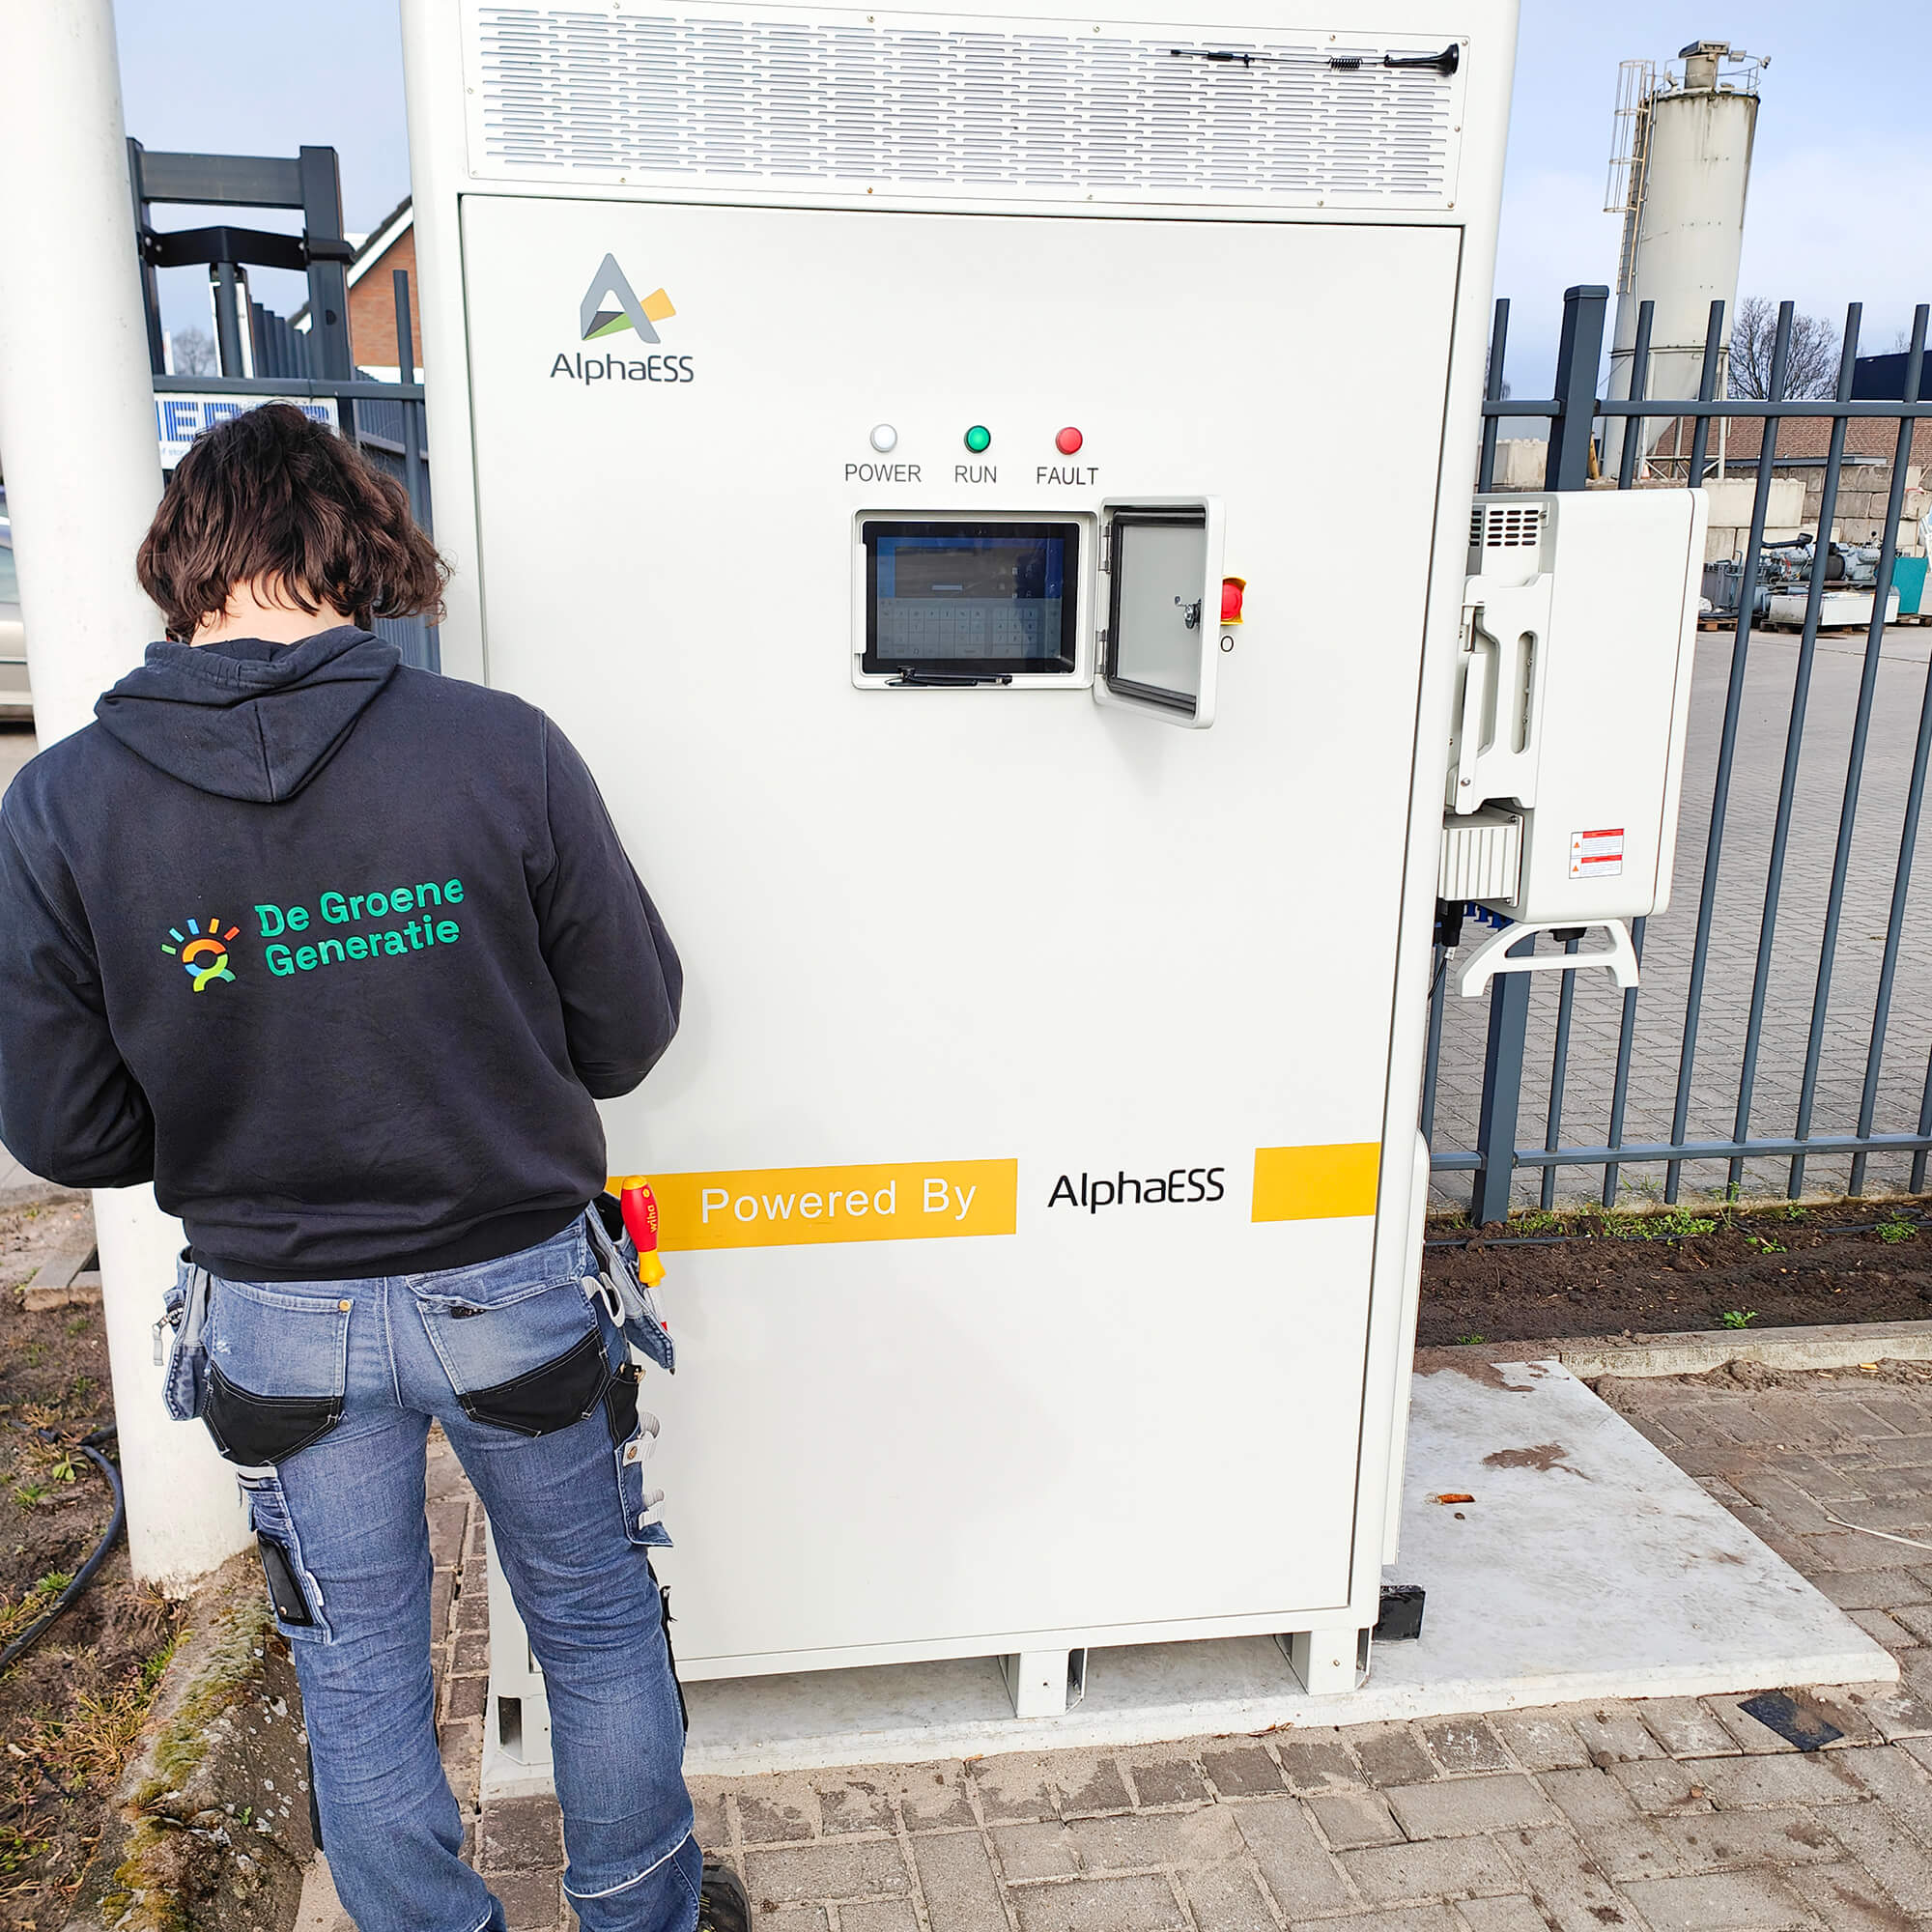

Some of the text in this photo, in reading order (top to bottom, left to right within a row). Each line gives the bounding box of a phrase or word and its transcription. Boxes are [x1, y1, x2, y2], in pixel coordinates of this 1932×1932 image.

[550, 352, 695, 385] AlphaESS
[844, 464, 922, 482] POWER
[954, 465, 997, 483] RUN
[1036, 467, 1099, 485] FAULT
[254, 878, 465, 938] De Groene
[264, 914, 461, 978] Generatie
[701, 1178, 977, 1223] Powered By
[1047, 1167, 1225, 1214] AlphaESS
